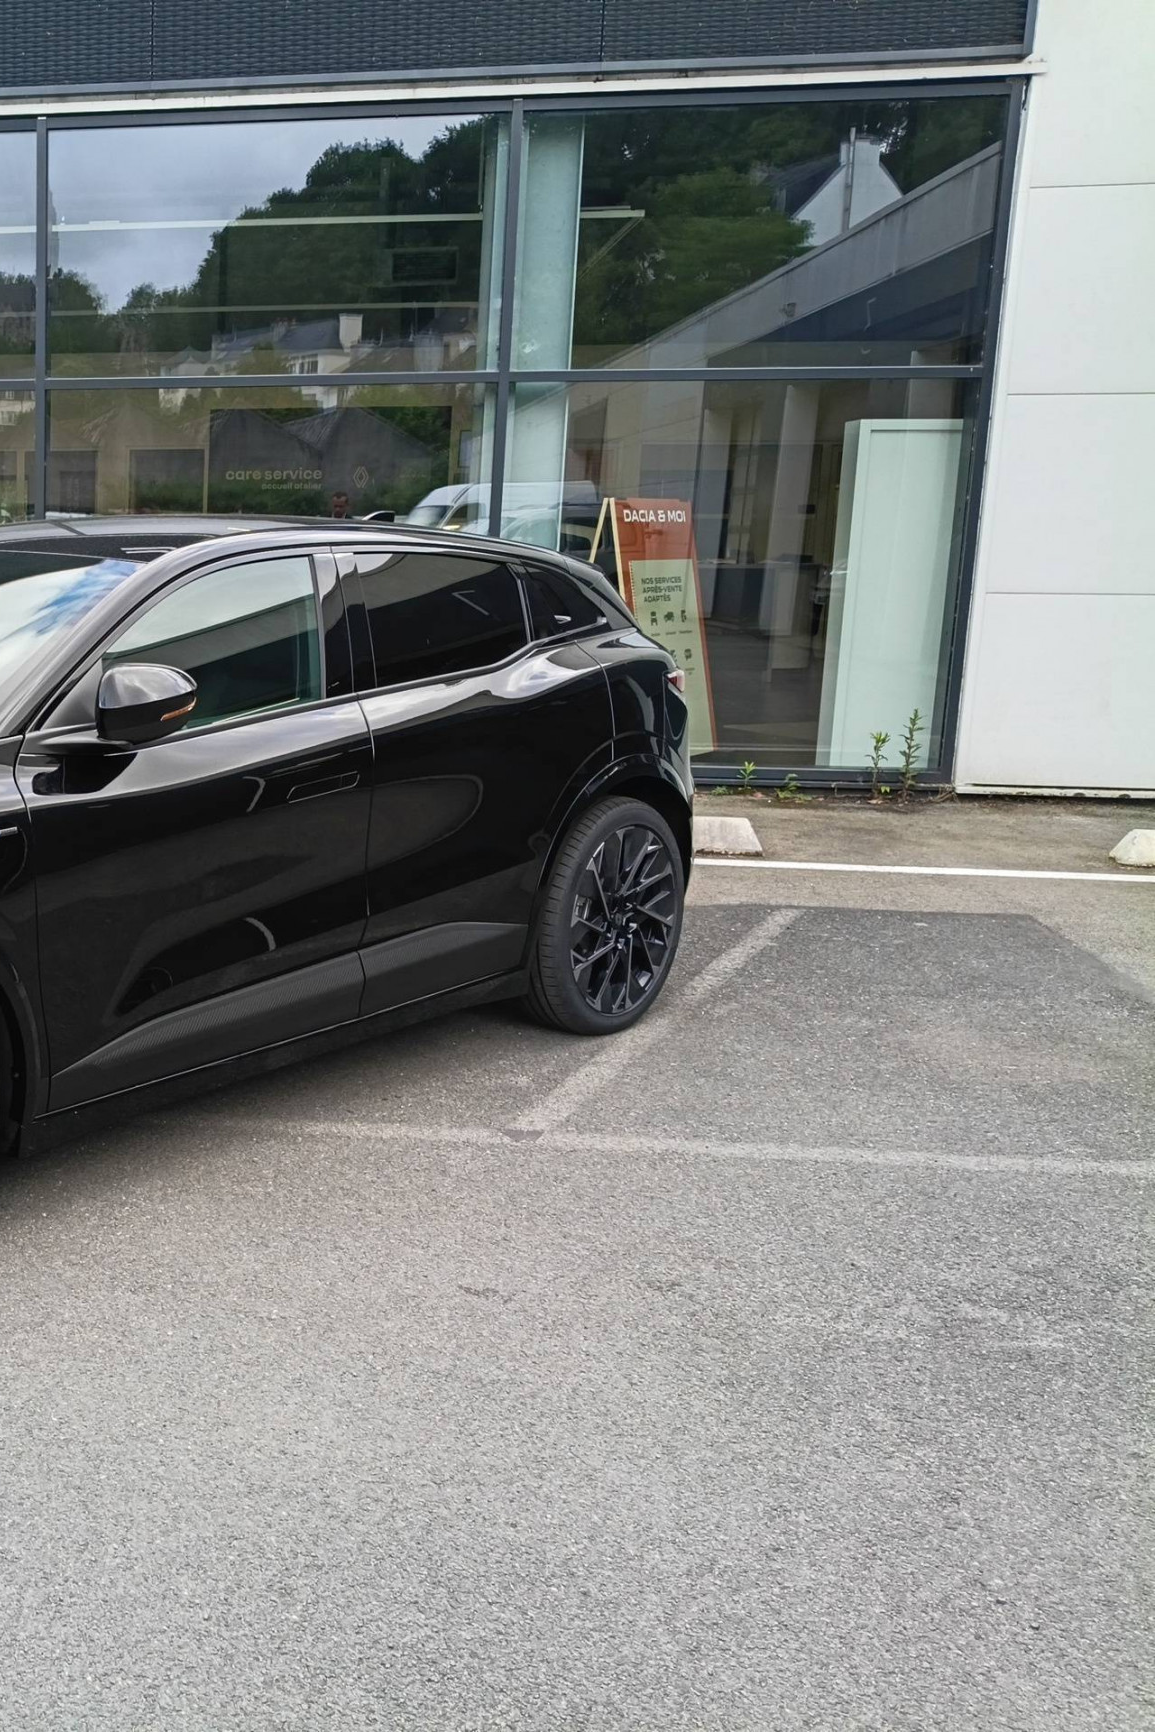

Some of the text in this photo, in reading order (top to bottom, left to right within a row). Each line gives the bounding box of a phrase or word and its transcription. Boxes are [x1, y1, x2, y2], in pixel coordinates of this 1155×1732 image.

[225, 467, 323, 481] care service
[623, 509, 687, 523] DACIA & MOI
